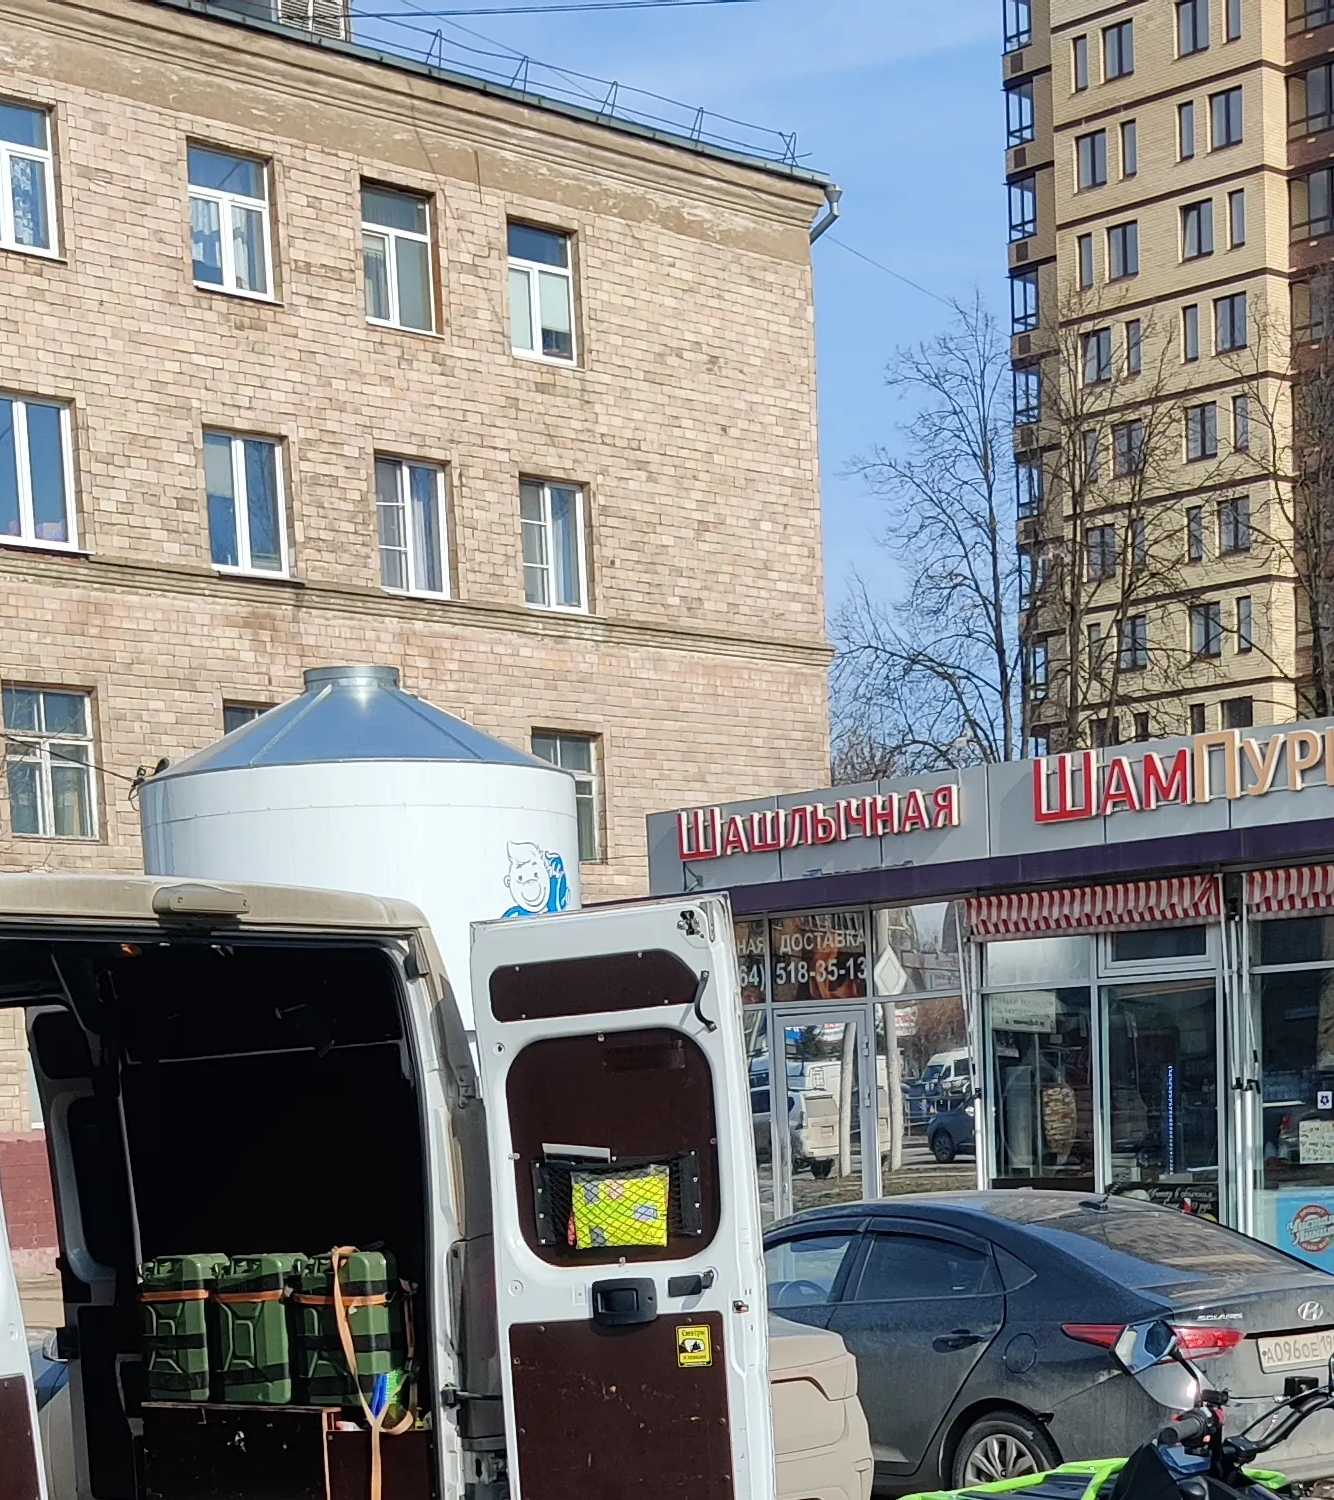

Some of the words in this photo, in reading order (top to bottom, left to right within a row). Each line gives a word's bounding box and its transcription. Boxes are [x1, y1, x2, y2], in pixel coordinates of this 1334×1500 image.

[677, 784, 959, 861] ШАШЛЫЧНАЯ
[779, 929, 866, 955] ДОСТАВКА
[776, 956, 866, 985] 518-35-13
[1196, 1312, 1243, 1321] SOLARIS
